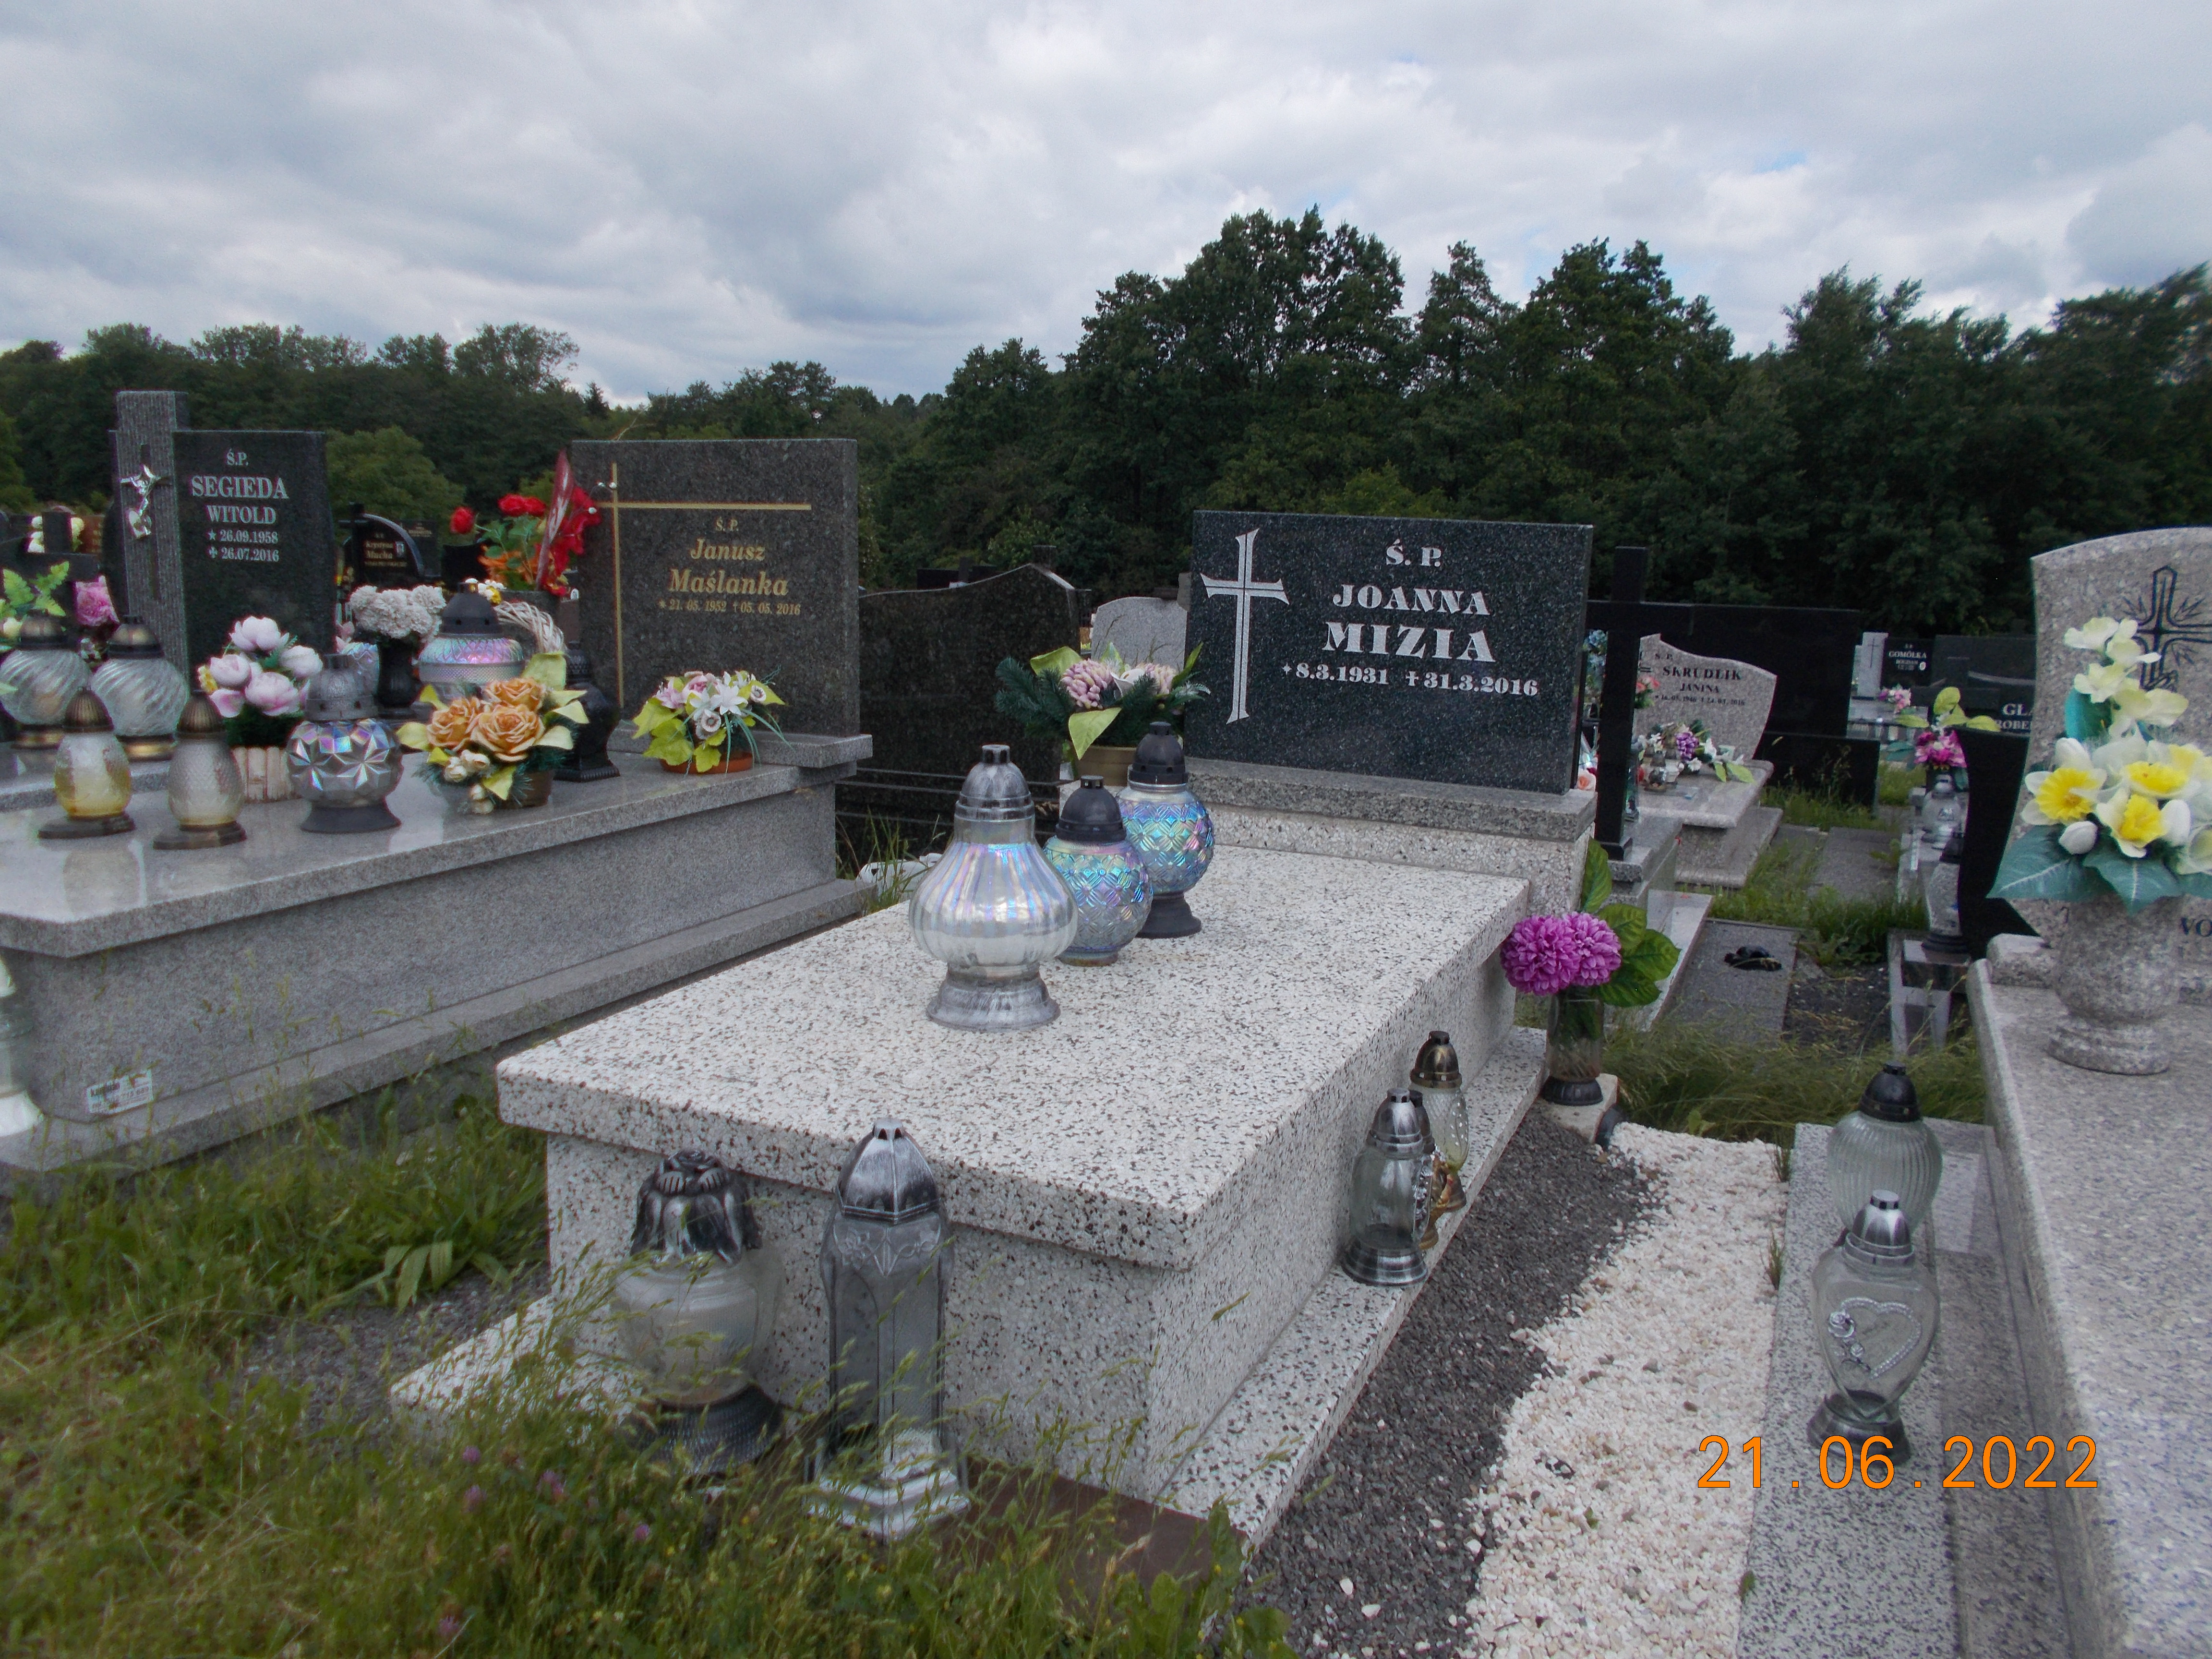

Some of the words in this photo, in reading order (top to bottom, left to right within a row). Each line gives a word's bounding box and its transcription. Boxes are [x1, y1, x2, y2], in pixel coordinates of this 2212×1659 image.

[192, 475, 289, 499] SEGIEDA
[206, 505, 276, 524] WITOLD
[220, 529, 279, 544] 26.09.1958
[221, 547, 280, 562] 26.07.2016
[690, 538, 765, 561] Janusz
[1419, 547, 1442, 567] P.
[669, 568, 789, 596] Maślanka
[776, 604, 801, 616] 2016
[1332, 584, 1491, 616] JOANNA
[1322, 622, 1496, 663] MIZIA
[1296, 662, 1389, 685] 8.3.1931
[1424, 671, 1538, 697] 31.3.2016
[1662, 666, 1742, 680] SKRUDLIK
[1680, 683, 1719, 693] JANINA
